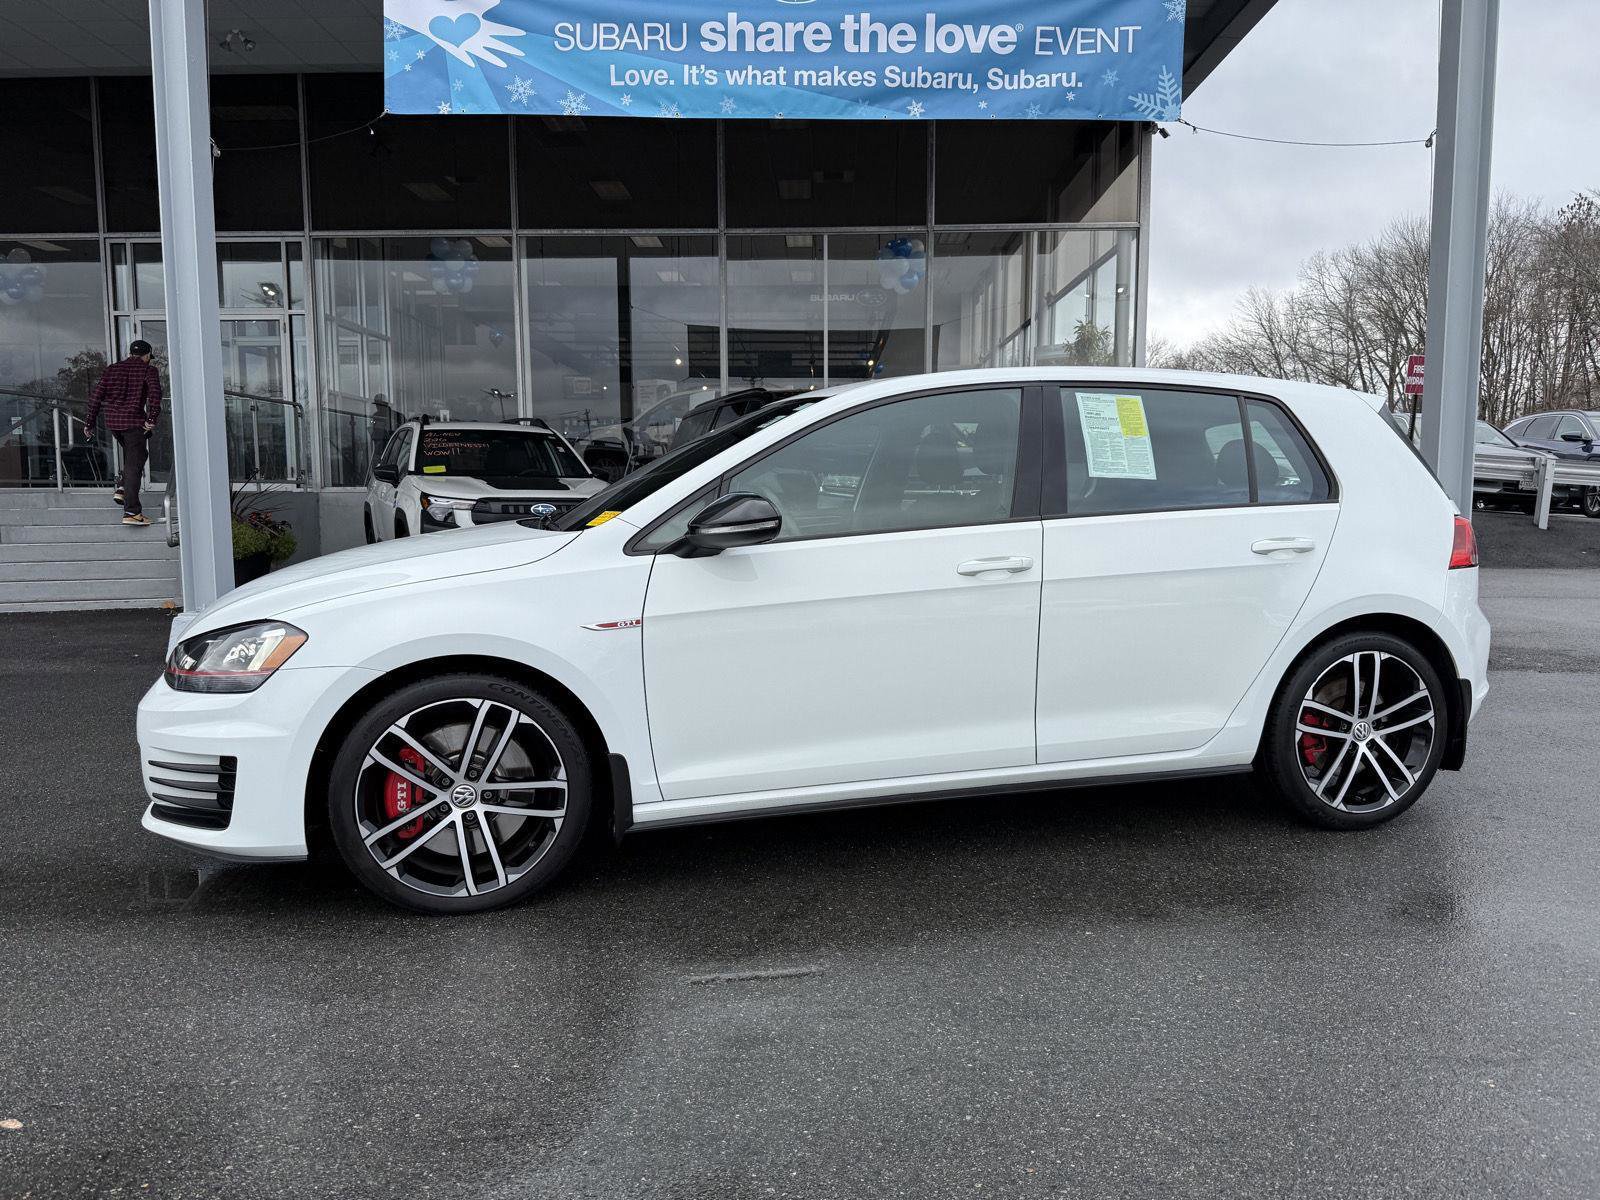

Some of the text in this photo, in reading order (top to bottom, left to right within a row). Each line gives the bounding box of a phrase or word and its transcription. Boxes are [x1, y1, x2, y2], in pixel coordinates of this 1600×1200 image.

[554, 22, 688, 52] SUBARU
[700, 12, 832, 54] share
[840, 13, 918, 54] the
[1034, 25, 1142, 56] EVENT
[609, 64, 675, 87] Love.
[725, 65, 787, 87] what
[794, 65, 877, 88] makes
[884, 66, 979, 94] Subaru,
[986, 67, 1083, 90] Subaru.
[1406, 376, 1424, 385] HYDRA
[617, 620, 637, 628] GTI
[397, 782, 407, 812] GTI
